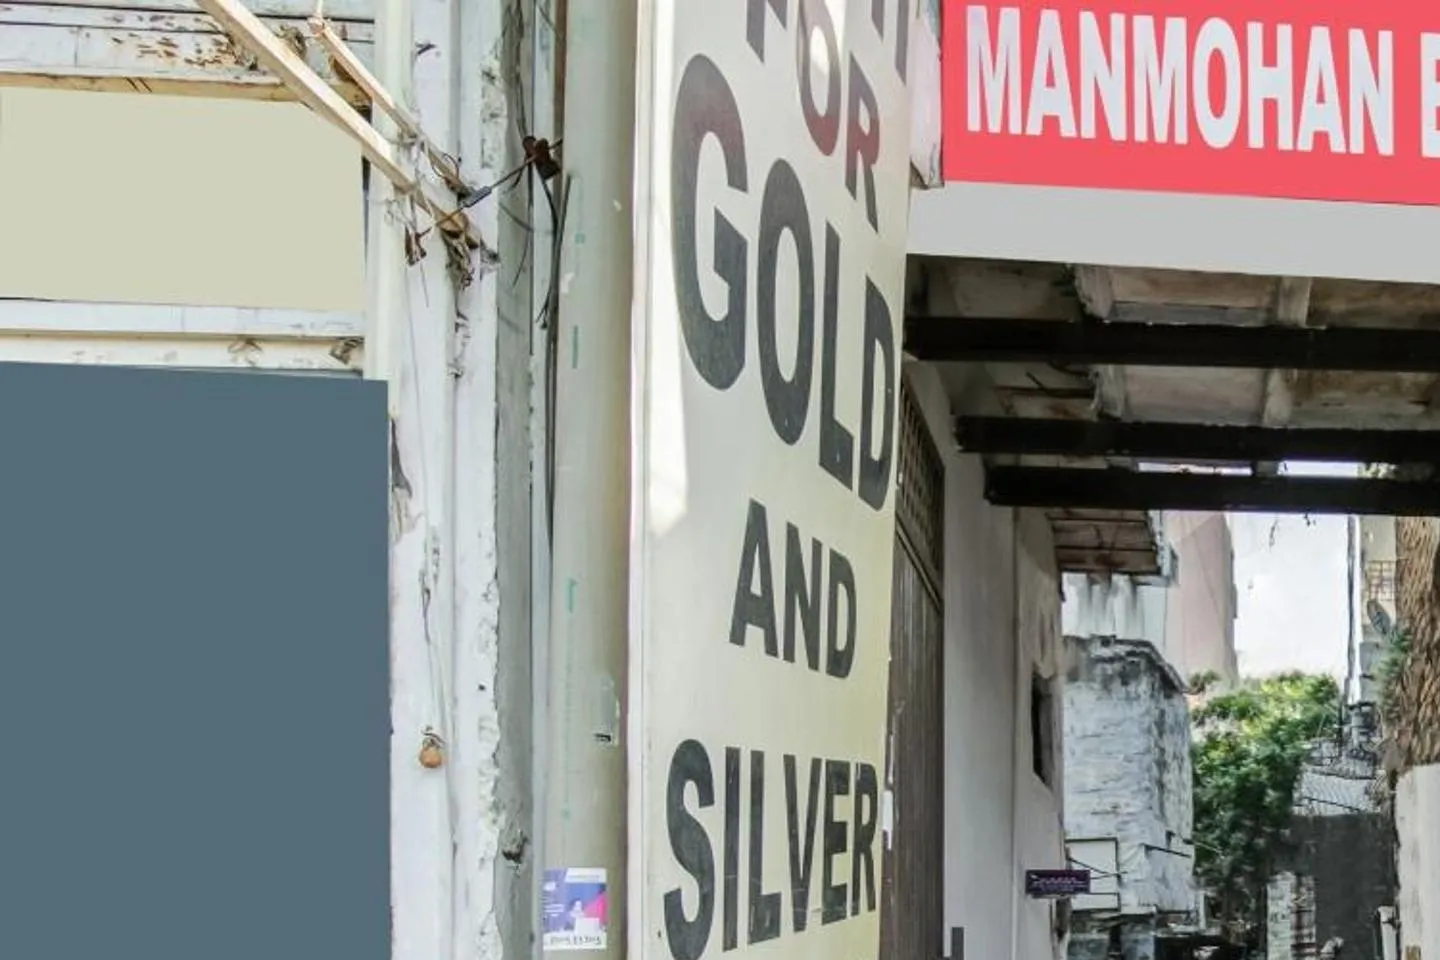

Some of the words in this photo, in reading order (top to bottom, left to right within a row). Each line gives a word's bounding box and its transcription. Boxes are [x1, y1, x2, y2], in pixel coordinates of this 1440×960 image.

[965, 5, 1395, 155] MANMOHAN
[671, 53, 894, 511] GOLD
[729, 498, 856, 678] AND
